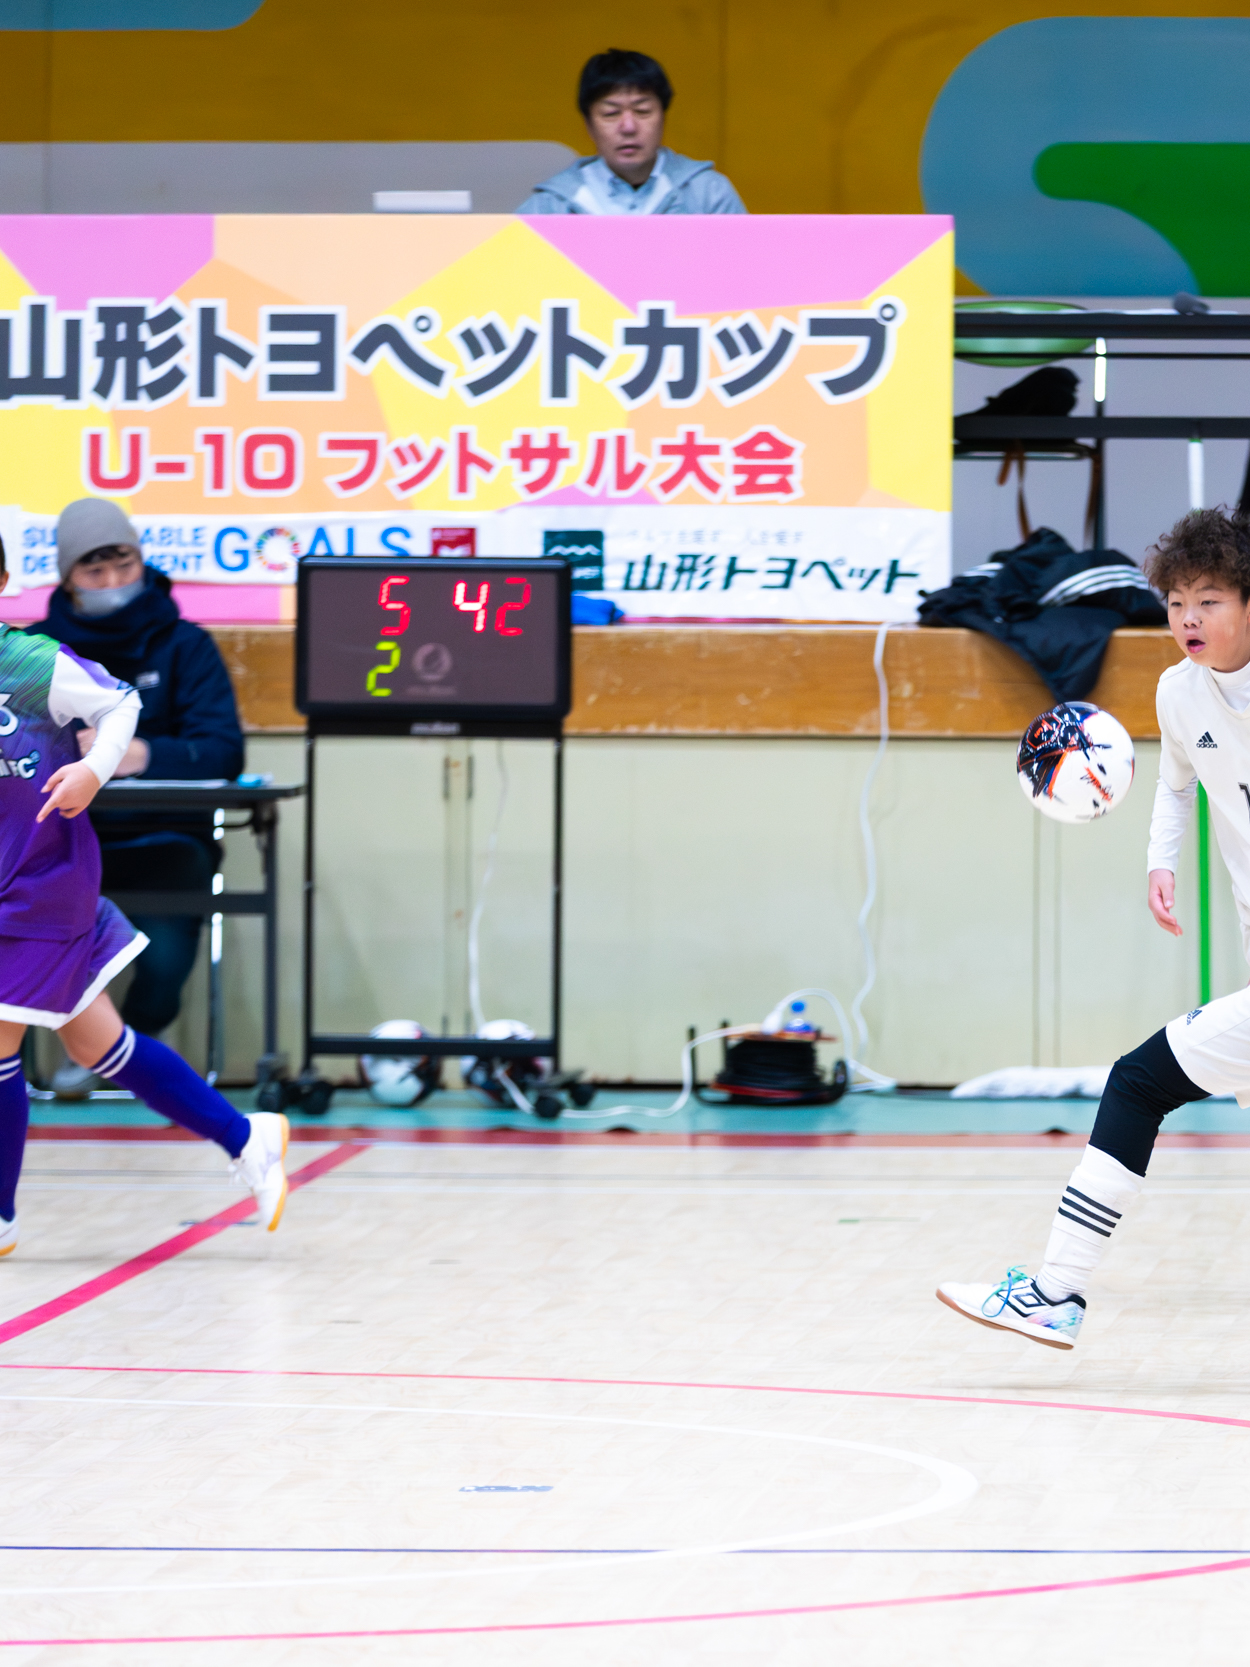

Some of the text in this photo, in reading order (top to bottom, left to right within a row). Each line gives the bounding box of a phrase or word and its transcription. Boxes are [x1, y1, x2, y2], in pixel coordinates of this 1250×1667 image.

[0, 303, 896, 402] 山形トヨペットカップ
[88, 430, 795, 496] U-10 フットサル大会
[623, 554, 919, 594] 山形トヨペット
[378, 575, 531, 637] 5 42
[366, 641, 400, 697] 2
